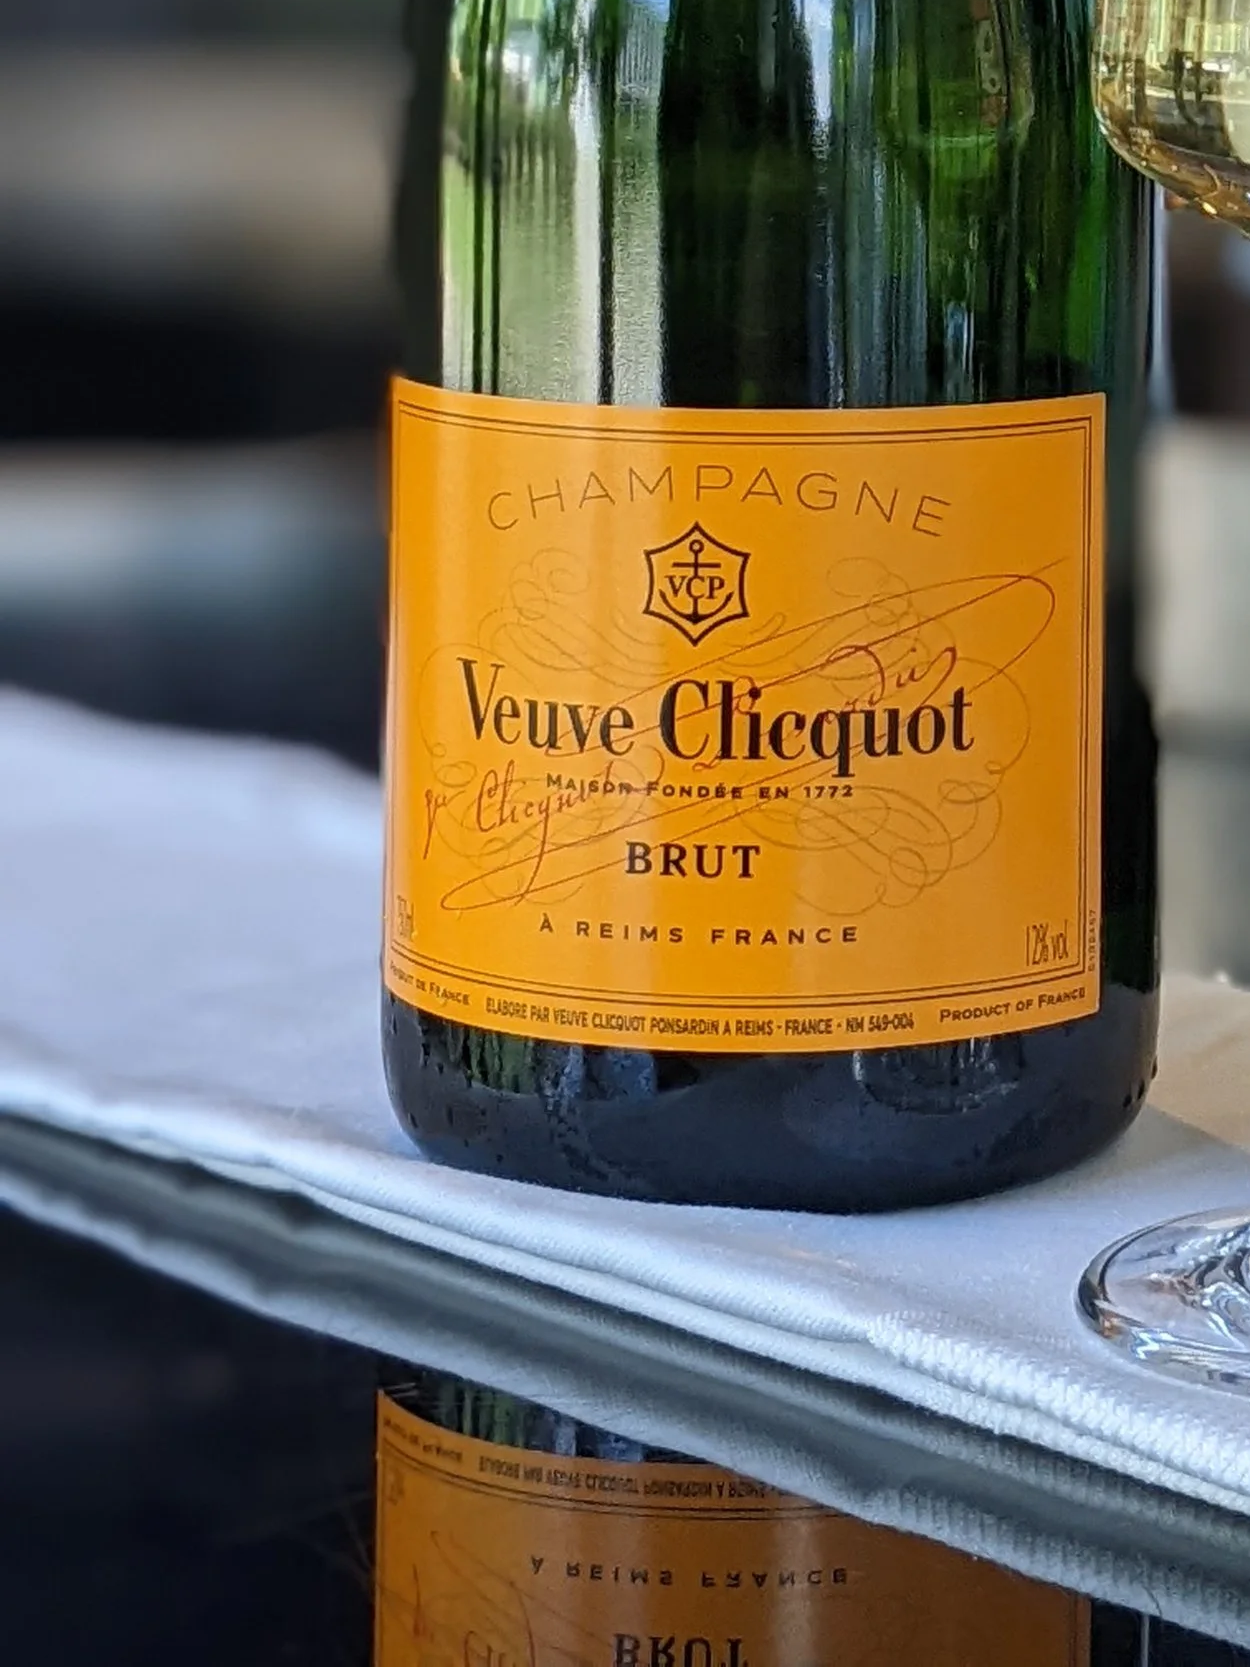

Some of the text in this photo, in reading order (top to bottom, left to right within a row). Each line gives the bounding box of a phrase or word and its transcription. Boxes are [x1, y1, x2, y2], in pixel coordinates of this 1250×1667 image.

[489, 464, 952, 537] CHAMPAGNE
[664, 575, 725, 600] VCP
[457, 657, 974, 778] Veuve Clicquot
[647, 782, 743, 800] FONDÉE
[759, 785, 789, 799] EN
[803, 784, 853, 799] 1772
[625, 841, 760, 879] BRUT
[576, 920, 684, 944] REIMS
[711, 926, 858, 946] FRANCE
[429, 981, 471, 1006] FRANCE
[939, 987, 1086, 1022] PRODUCT OF FRANCE
[530, 1005, 550, 1024] PAR
[552, 1007, 588, 1029] VEUVE
[591, 1013, 647, 1033] CLICQUOT
[651, 1016, 719, 1035] PONSARDIN
[735, 1019, 774, 1037] REIMS
[784, 1018, 833, 1036] FRANCE
